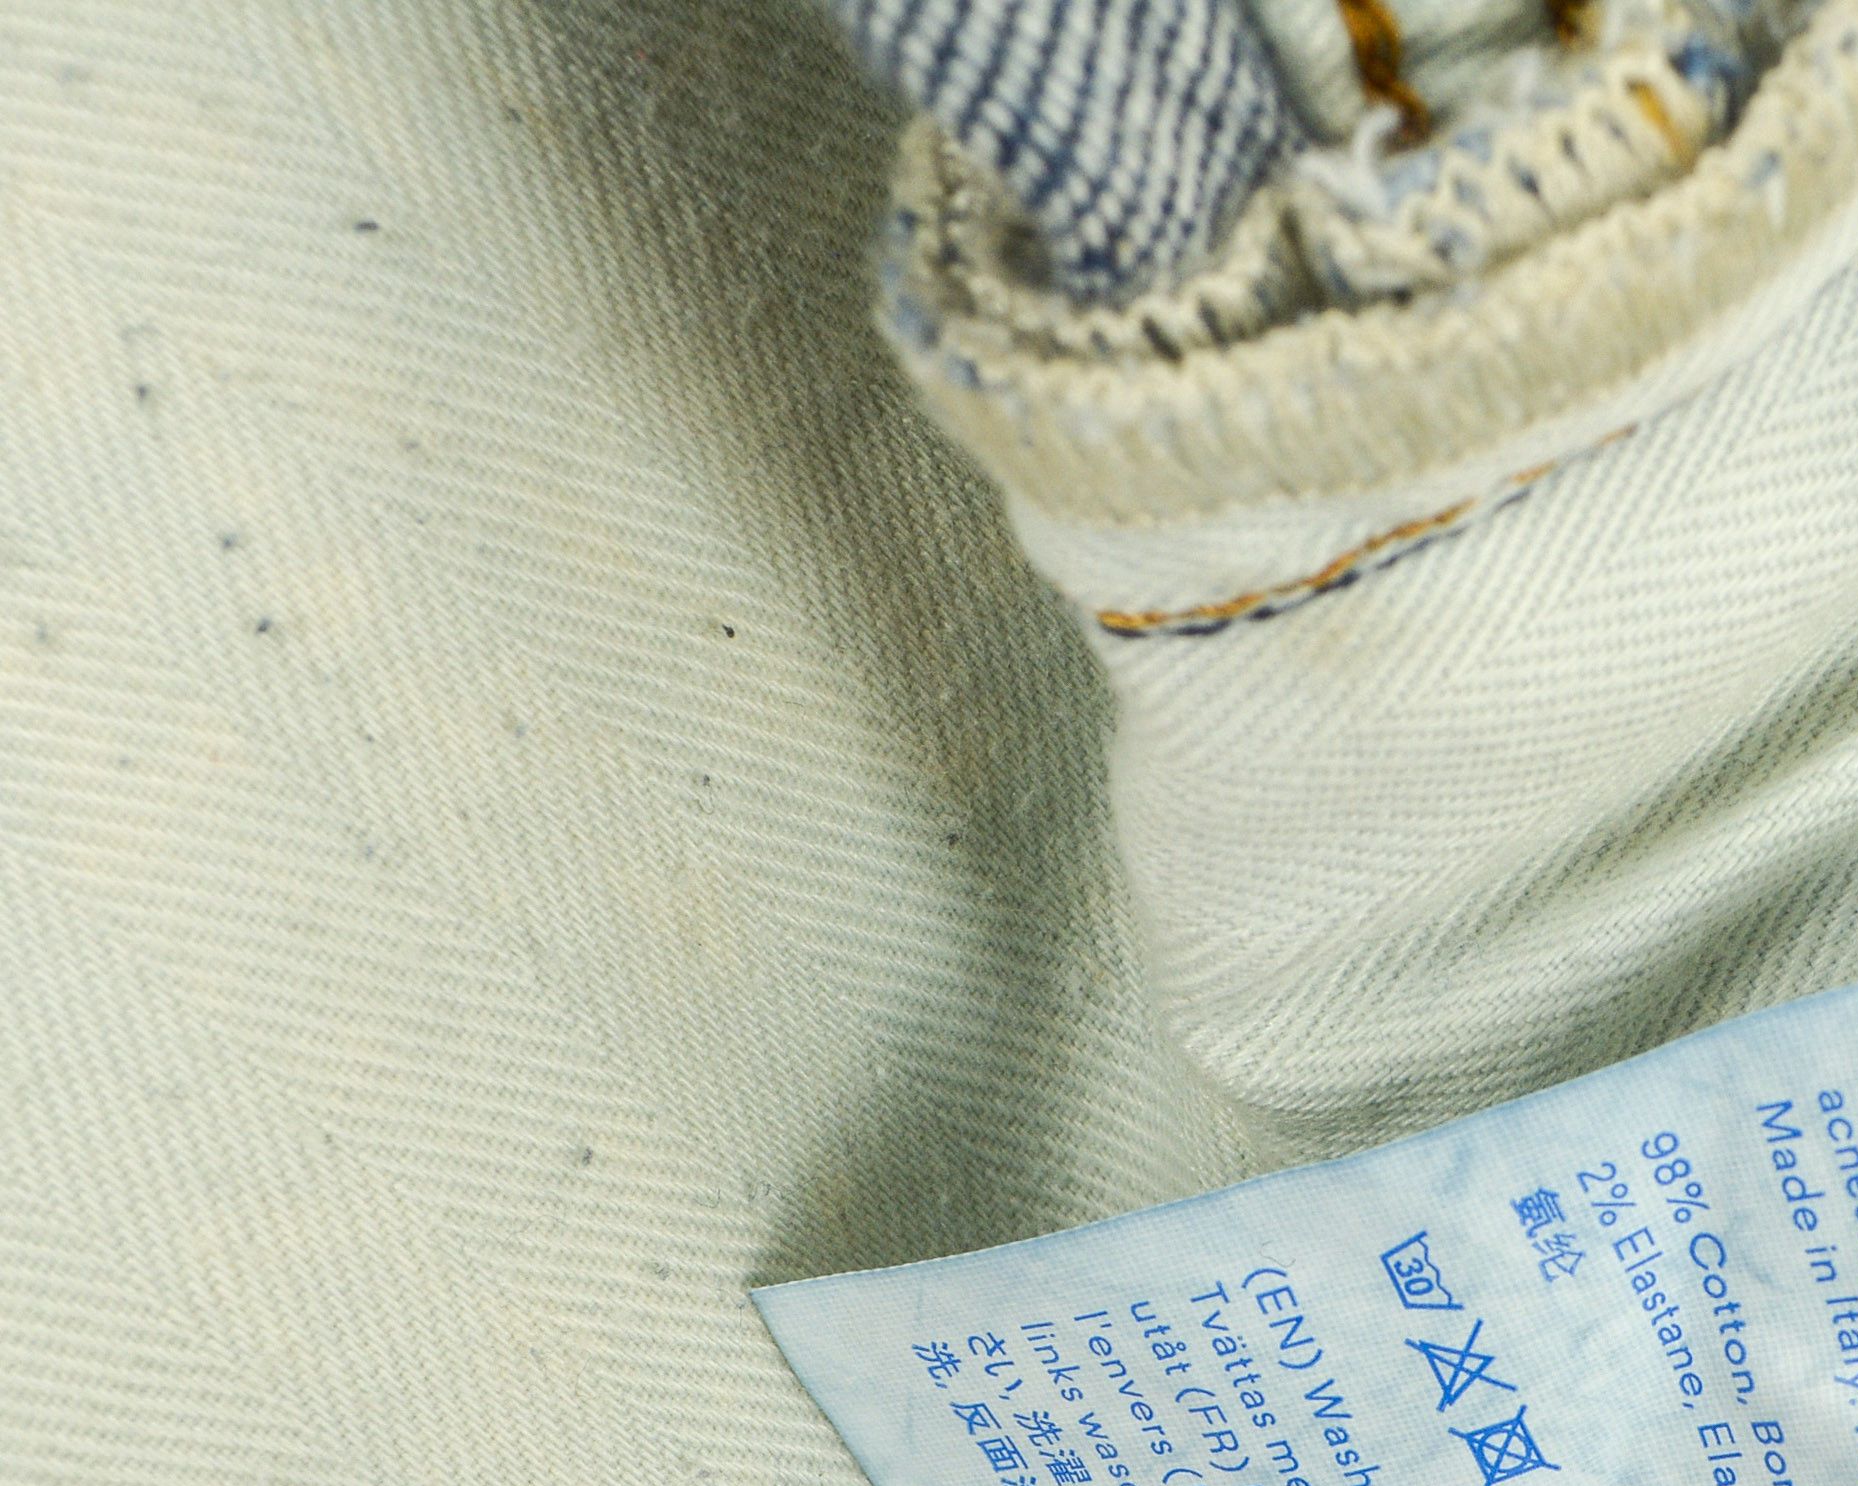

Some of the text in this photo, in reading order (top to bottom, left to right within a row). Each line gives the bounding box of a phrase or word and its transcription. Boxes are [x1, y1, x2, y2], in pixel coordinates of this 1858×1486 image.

[1754, 1099, 1825, 1232] Made
[1806, 1244, 1838, 1284] in
[1240, 1267, 1324, 1371] (EN)
[1394, 1257, 1433, 1295] 30
[1576, 1161, 1635, 1227] 2%
[1612, 1227, 1704, 1409] Elastane,
[1640, 1130, 1710, 1225] 98%
[1688, 1231, 1756, 1405] Cotton,
[1021, 1322, 1083, 1402] links
[1074, 1309, 1174, 1456] l'envers
[1129, 1300, 1191, 1376] utåt
[1175, 1386, 1250, 1472] (FR)
[1190, 1280, 1277, 1429] Tvättas
